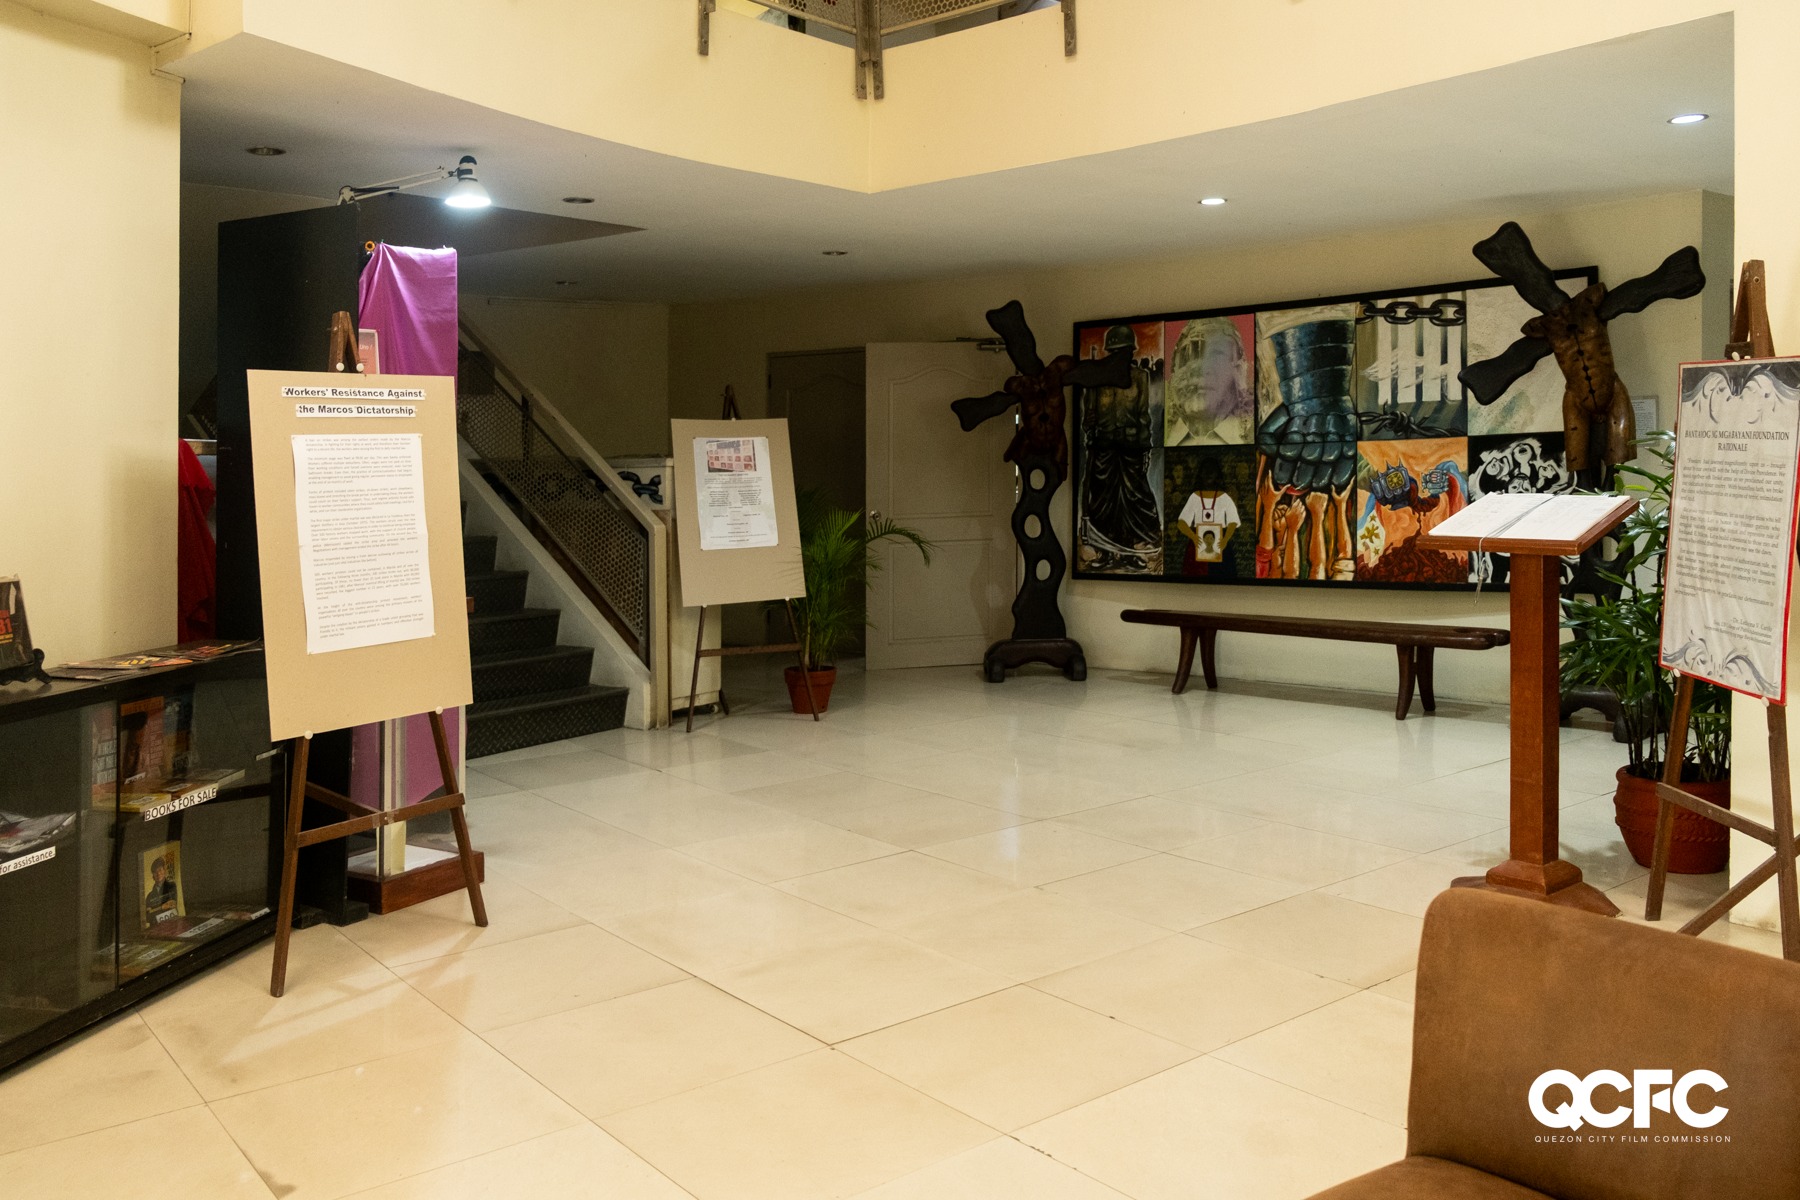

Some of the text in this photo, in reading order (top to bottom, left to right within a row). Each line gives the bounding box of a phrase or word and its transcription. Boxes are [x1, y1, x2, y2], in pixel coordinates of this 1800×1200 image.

[284, 387, 422, 399] Workers' Resistance Against
[298, 405, 414, 416] the Marcos Dictatorship
[1752, 431, 1790, 440] FOUNDATION
[1717, 442, 1748, 452] RATIONALE
[145, 788, 217, 821] BOOKS FOR SALE
